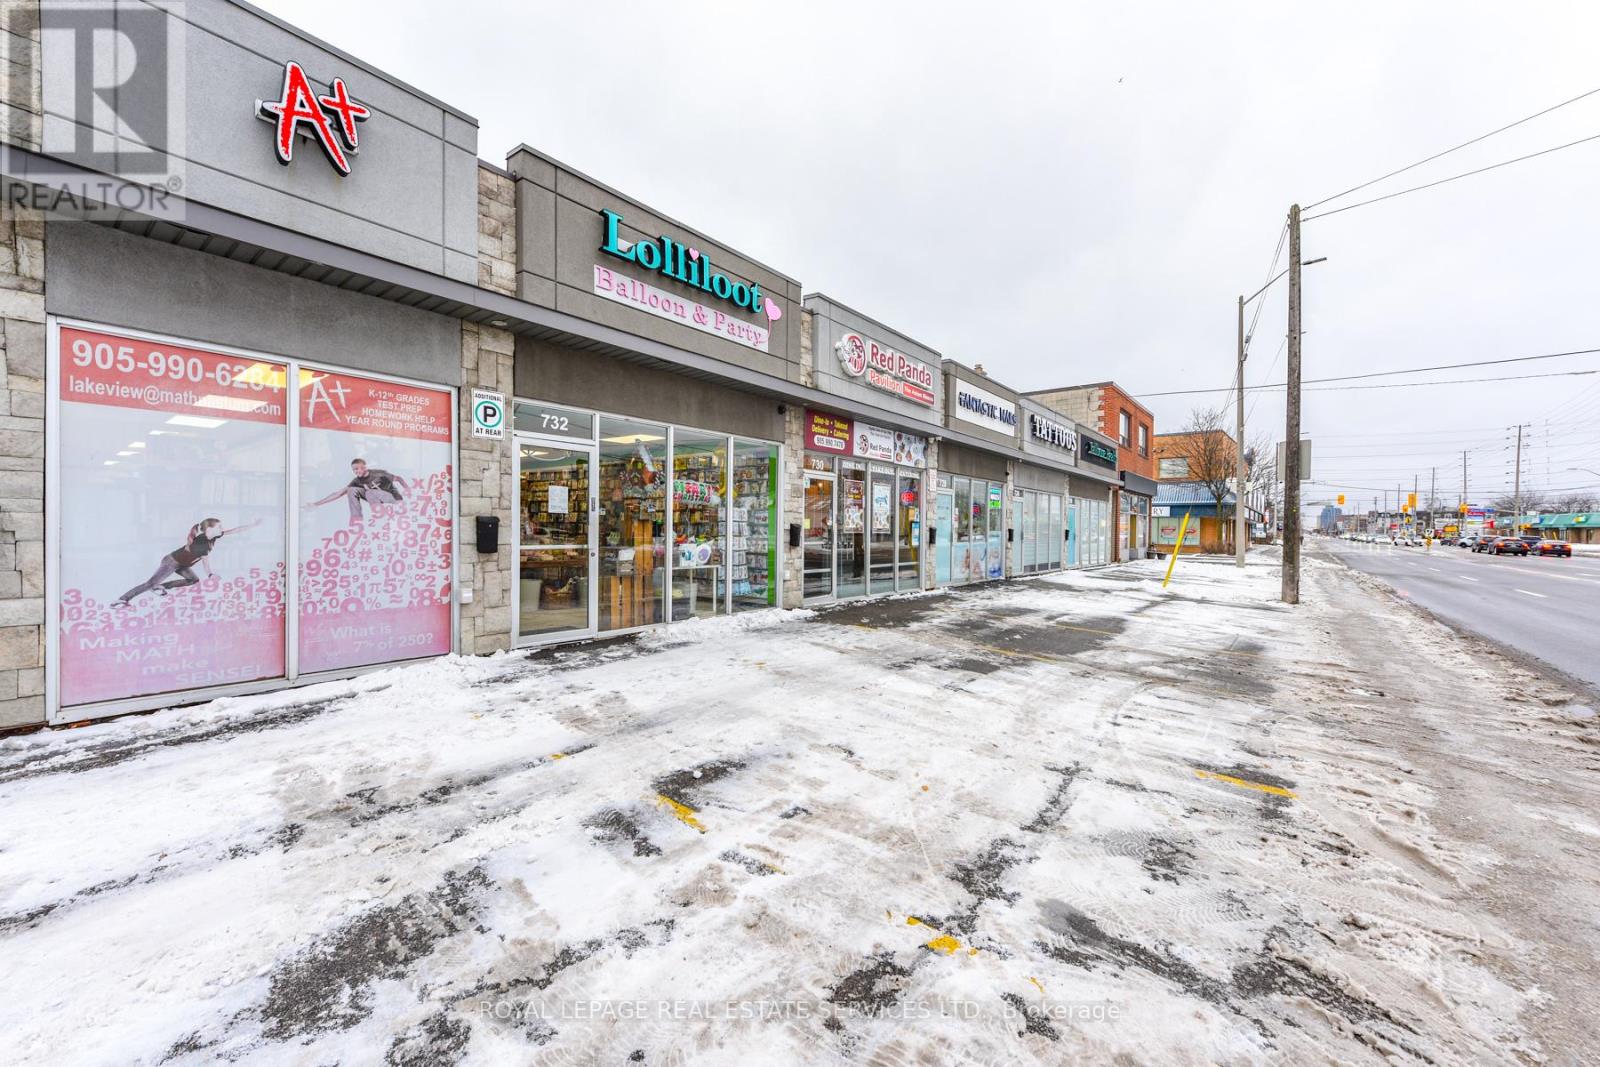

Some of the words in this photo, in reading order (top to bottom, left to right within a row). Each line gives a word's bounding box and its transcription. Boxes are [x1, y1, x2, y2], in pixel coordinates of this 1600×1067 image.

[261, 60, 371, 177] A+
[599, 208, 763, 314] Lolliloot
[596, 267, 687, 320] Balloon
[693, 304, 708, 326] &
[713, 310, 762, 346] Party
[870, 343, 894, 371] Red
[898, 356, 932, 386] Panda
[869, 370, 900, 394] Pavilion
[306, 378, 352, 423] A+
[368, 389, 394, 400] K-12th
[396, 394, 430, 405] GRADES
[475, 393, 502, 402] ADDITIONAL
[959, 392, 998, 420] FANTASTIC
[362, 408, 415, 422] HOMEWORK
[415, 415, 436, 424] HELP
[377, 401, 400, 410] TEST
[400, 403, 423, 413] PREP
[345, 416, 370, 426] YEAR
[373, 419, 403, 430] ROUND
[404, 422, 449, 435] PROGRAMS
[541, 414, 568, 431] 732
[485, 429, 502, 437] REAR
[812, 459, 824, 470] 730
[330, 625, 376, 640] What
[380, 624, 392, 634] is
[79, 633, 179, 651] Making
[377, 638, 393, 650] of
[399, 633, 433, 649] 250?
[116, 643, 195, 664] MATH
[143, 660, 209, 676] make
[176, 665, 262, 686] SENSE!
